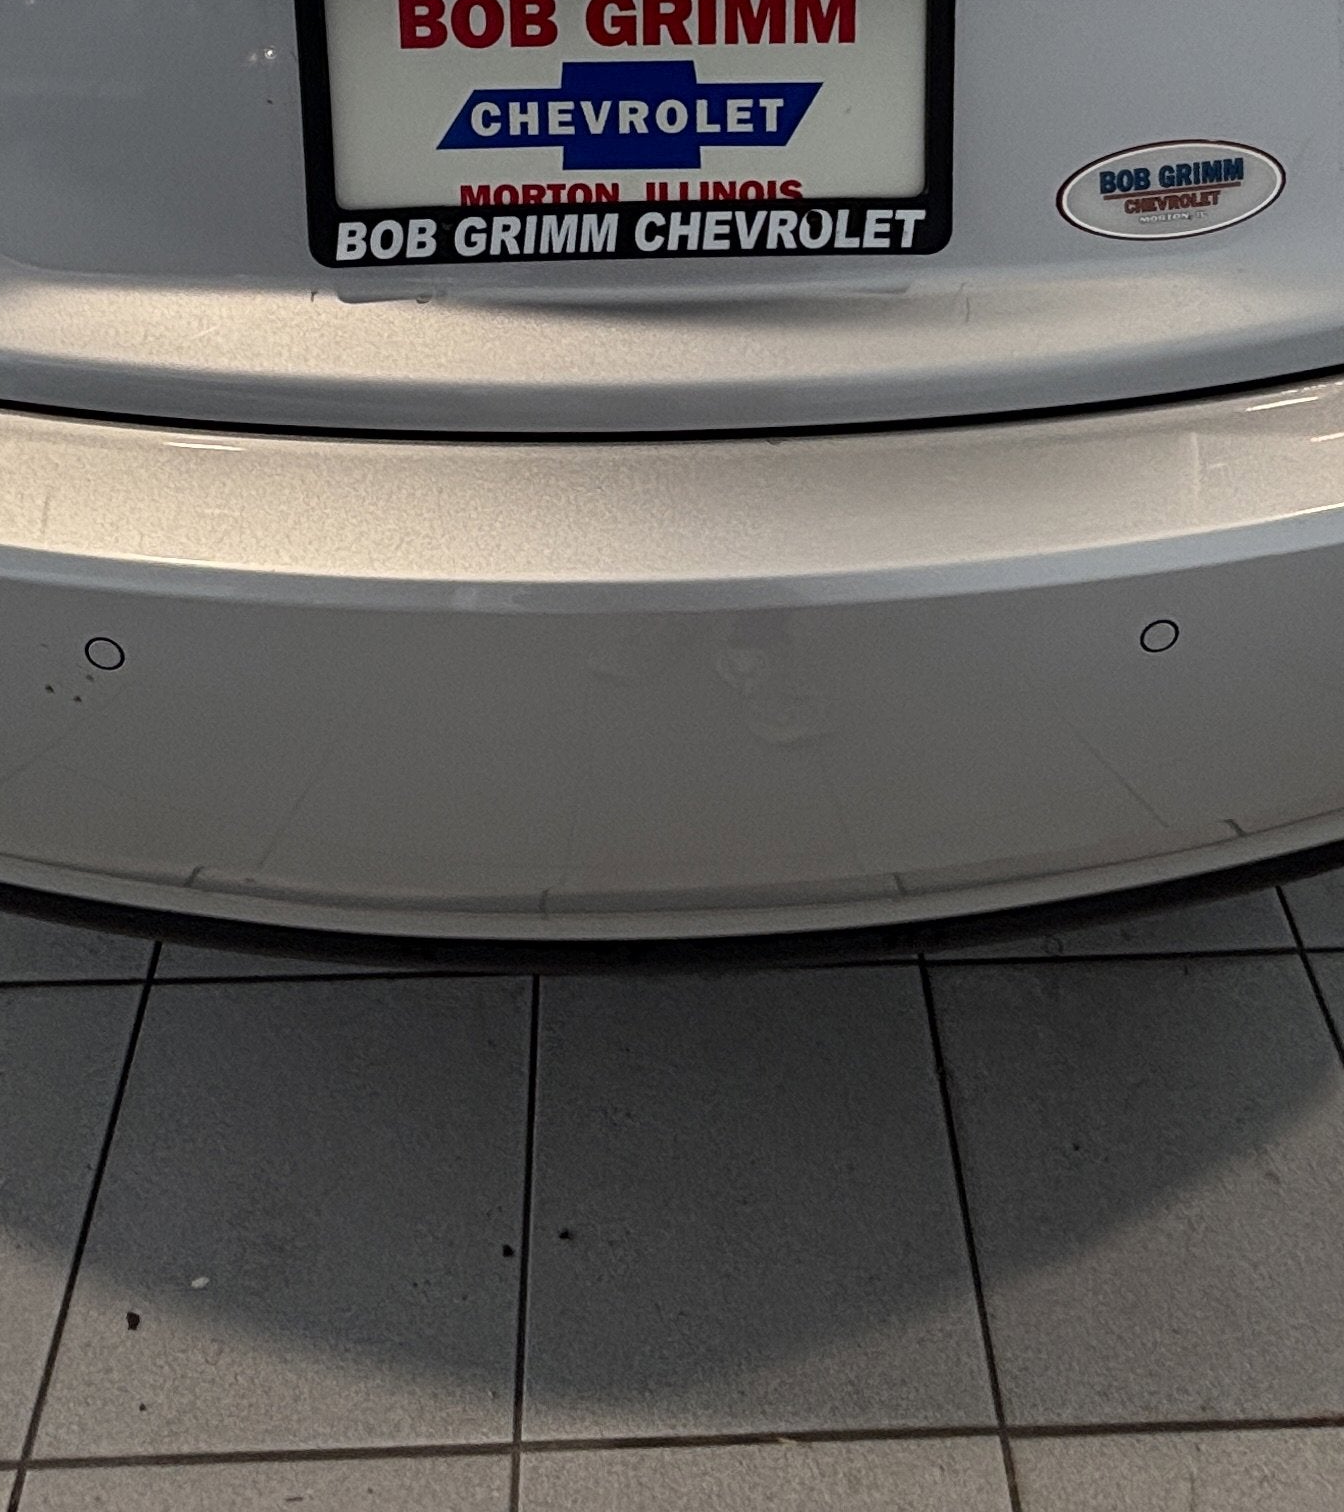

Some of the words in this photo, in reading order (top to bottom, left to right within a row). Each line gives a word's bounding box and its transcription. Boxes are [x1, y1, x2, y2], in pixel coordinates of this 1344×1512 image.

[469, 96, 786, 138] CHEVROLET
[459, 182, 620, 207] MORTON
[1098, 167, 1152, 195] BOB
[1158, 157, 1245, 190] GRIMM
[1123, 189, 1222, 215] CHEVROLET
[335, 217, 438, 262] BOB
[454, 212, 620, 257] GRIMM
[634, 208, 927, 252] CHEVROLET
